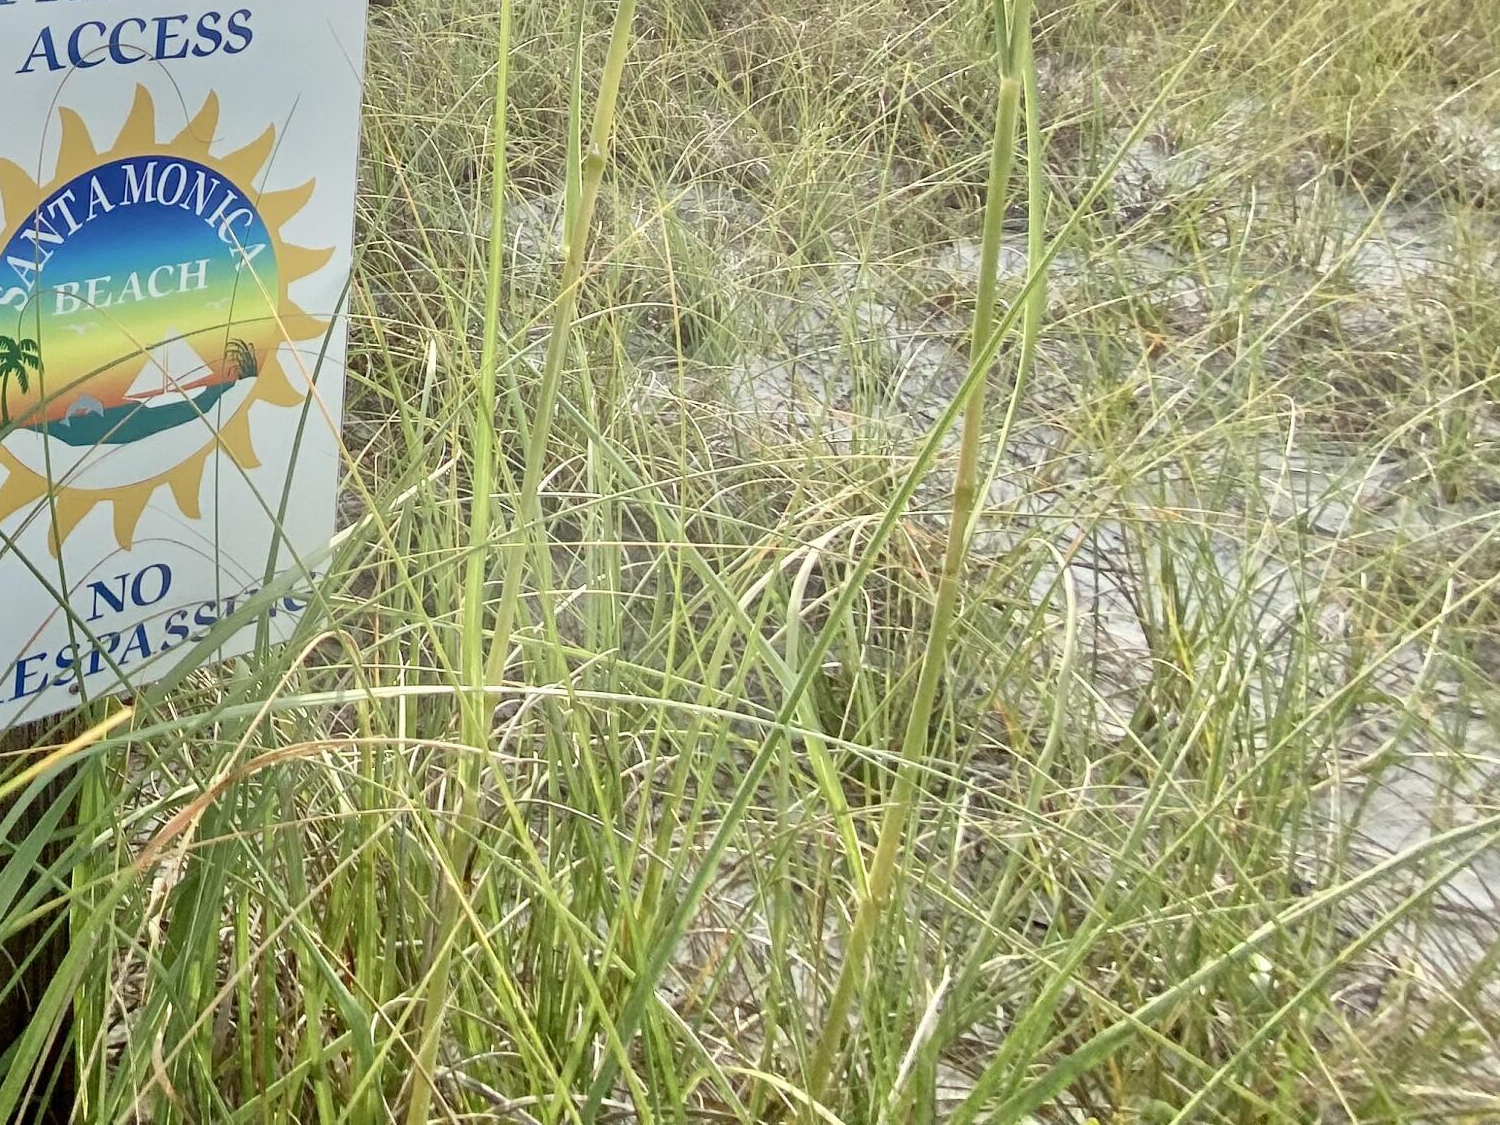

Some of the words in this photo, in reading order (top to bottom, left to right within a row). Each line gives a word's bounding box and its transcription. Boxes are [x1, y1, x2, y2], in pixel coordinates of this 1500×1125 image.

[15, 9, 254, 74] ACCESS
[119, 160, 267, 272] MONICA
[51, 258, 211, 316] BEACH
[85, 563, 173, 622] NO
